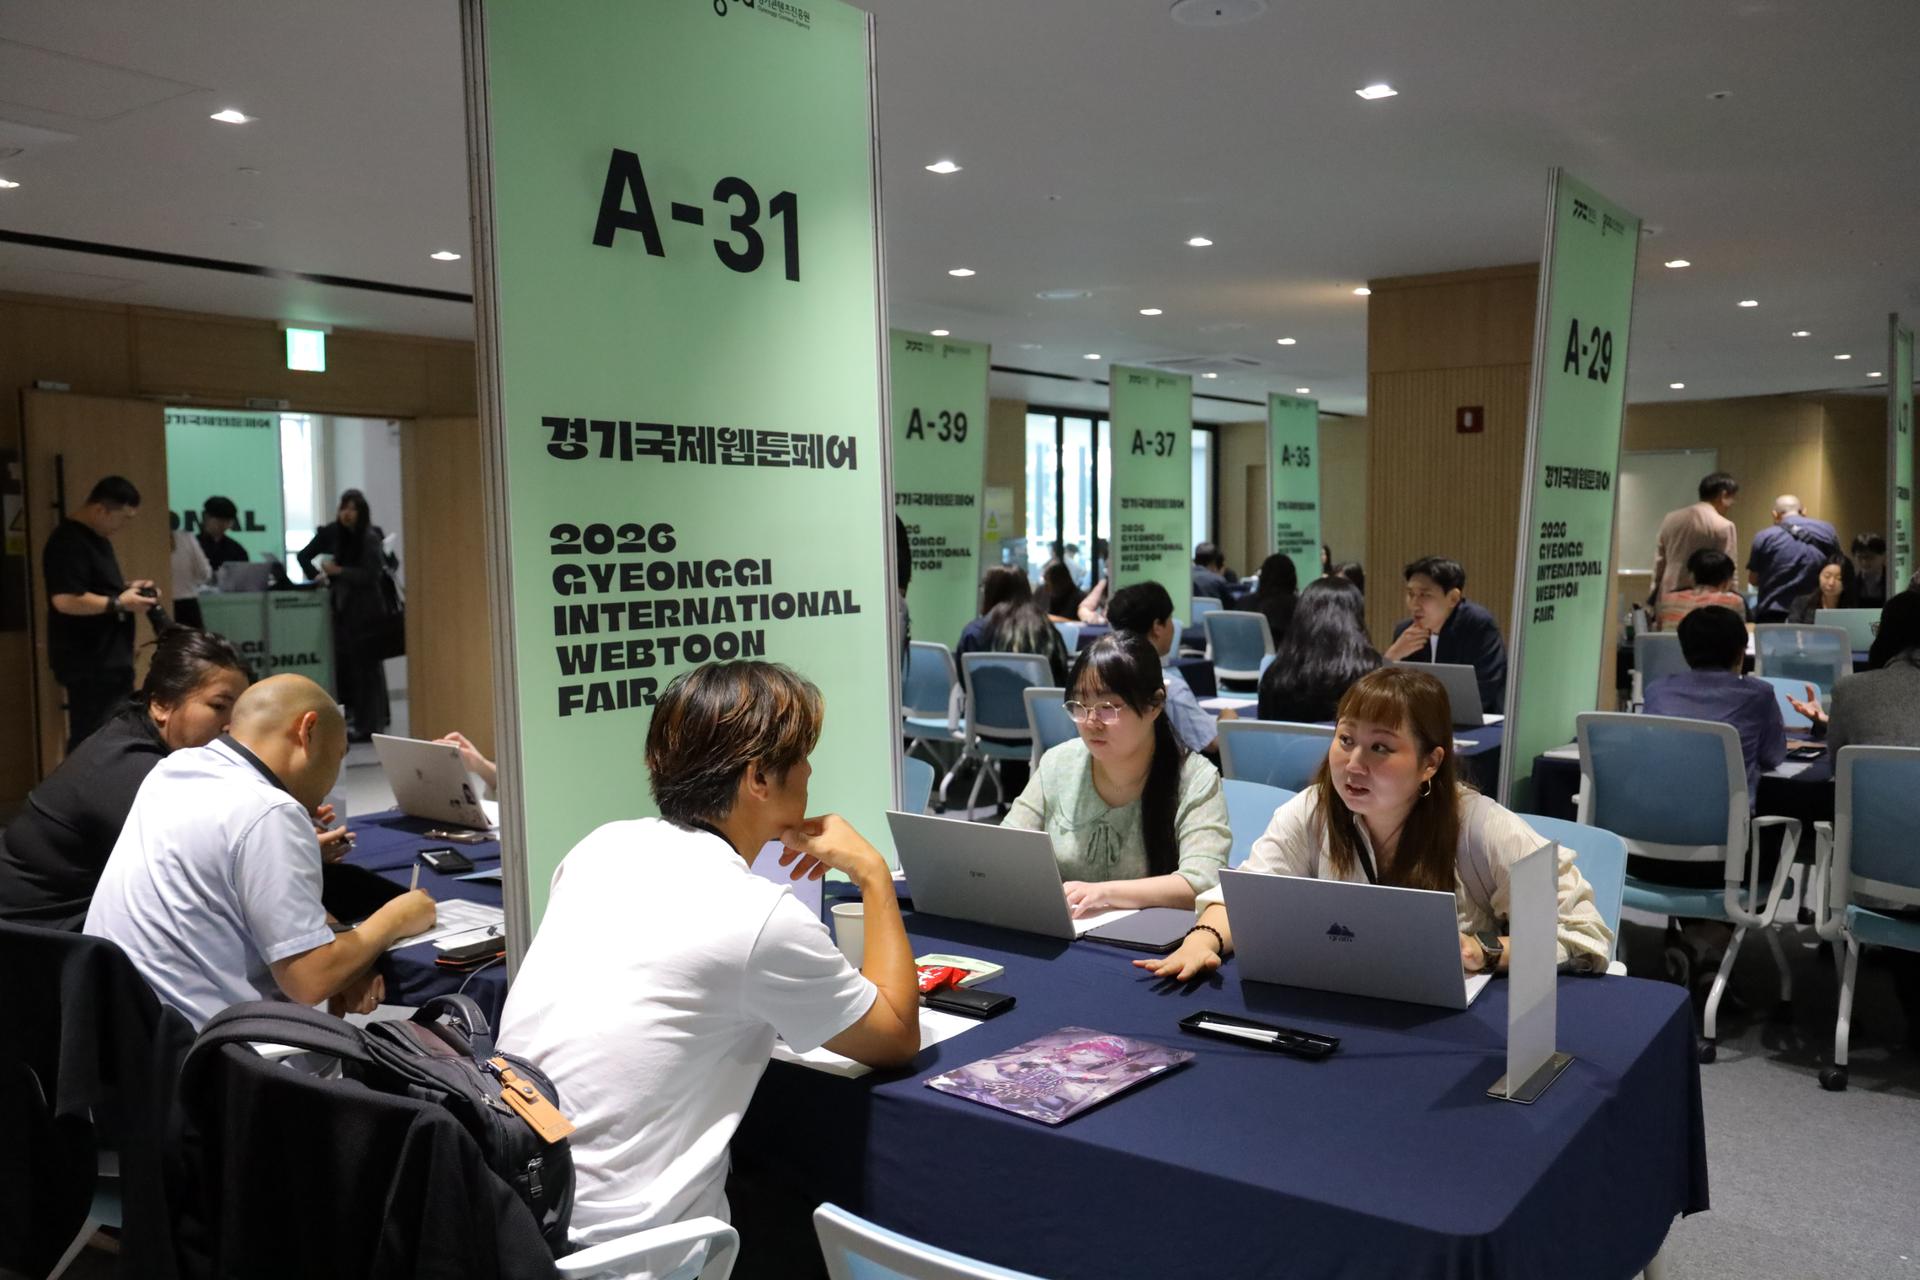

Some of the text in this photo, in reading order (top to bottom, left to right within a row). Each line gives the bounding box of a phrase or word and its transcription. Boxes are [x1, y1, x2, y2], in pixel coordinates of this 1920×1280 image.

[593, 148, 800, 282] A-31
[1563, 317, 1612, 384] A-29
[541, 416, 857, 470] 경기국제웹툰페어
[905, 408, 968, 443] A-39
[1131, 428, 1176, 457] A-37
[1281, 444, 1311, 468] A-35
[550, 523, 676, 555] 2026
[552, 558, 773, 596] GYEONGGI
[553, 589, 861, 636] INTERNATIONAL
[556, 630, 765, 676] WEBTOON
[558, 677, 659, 717] FAIR
